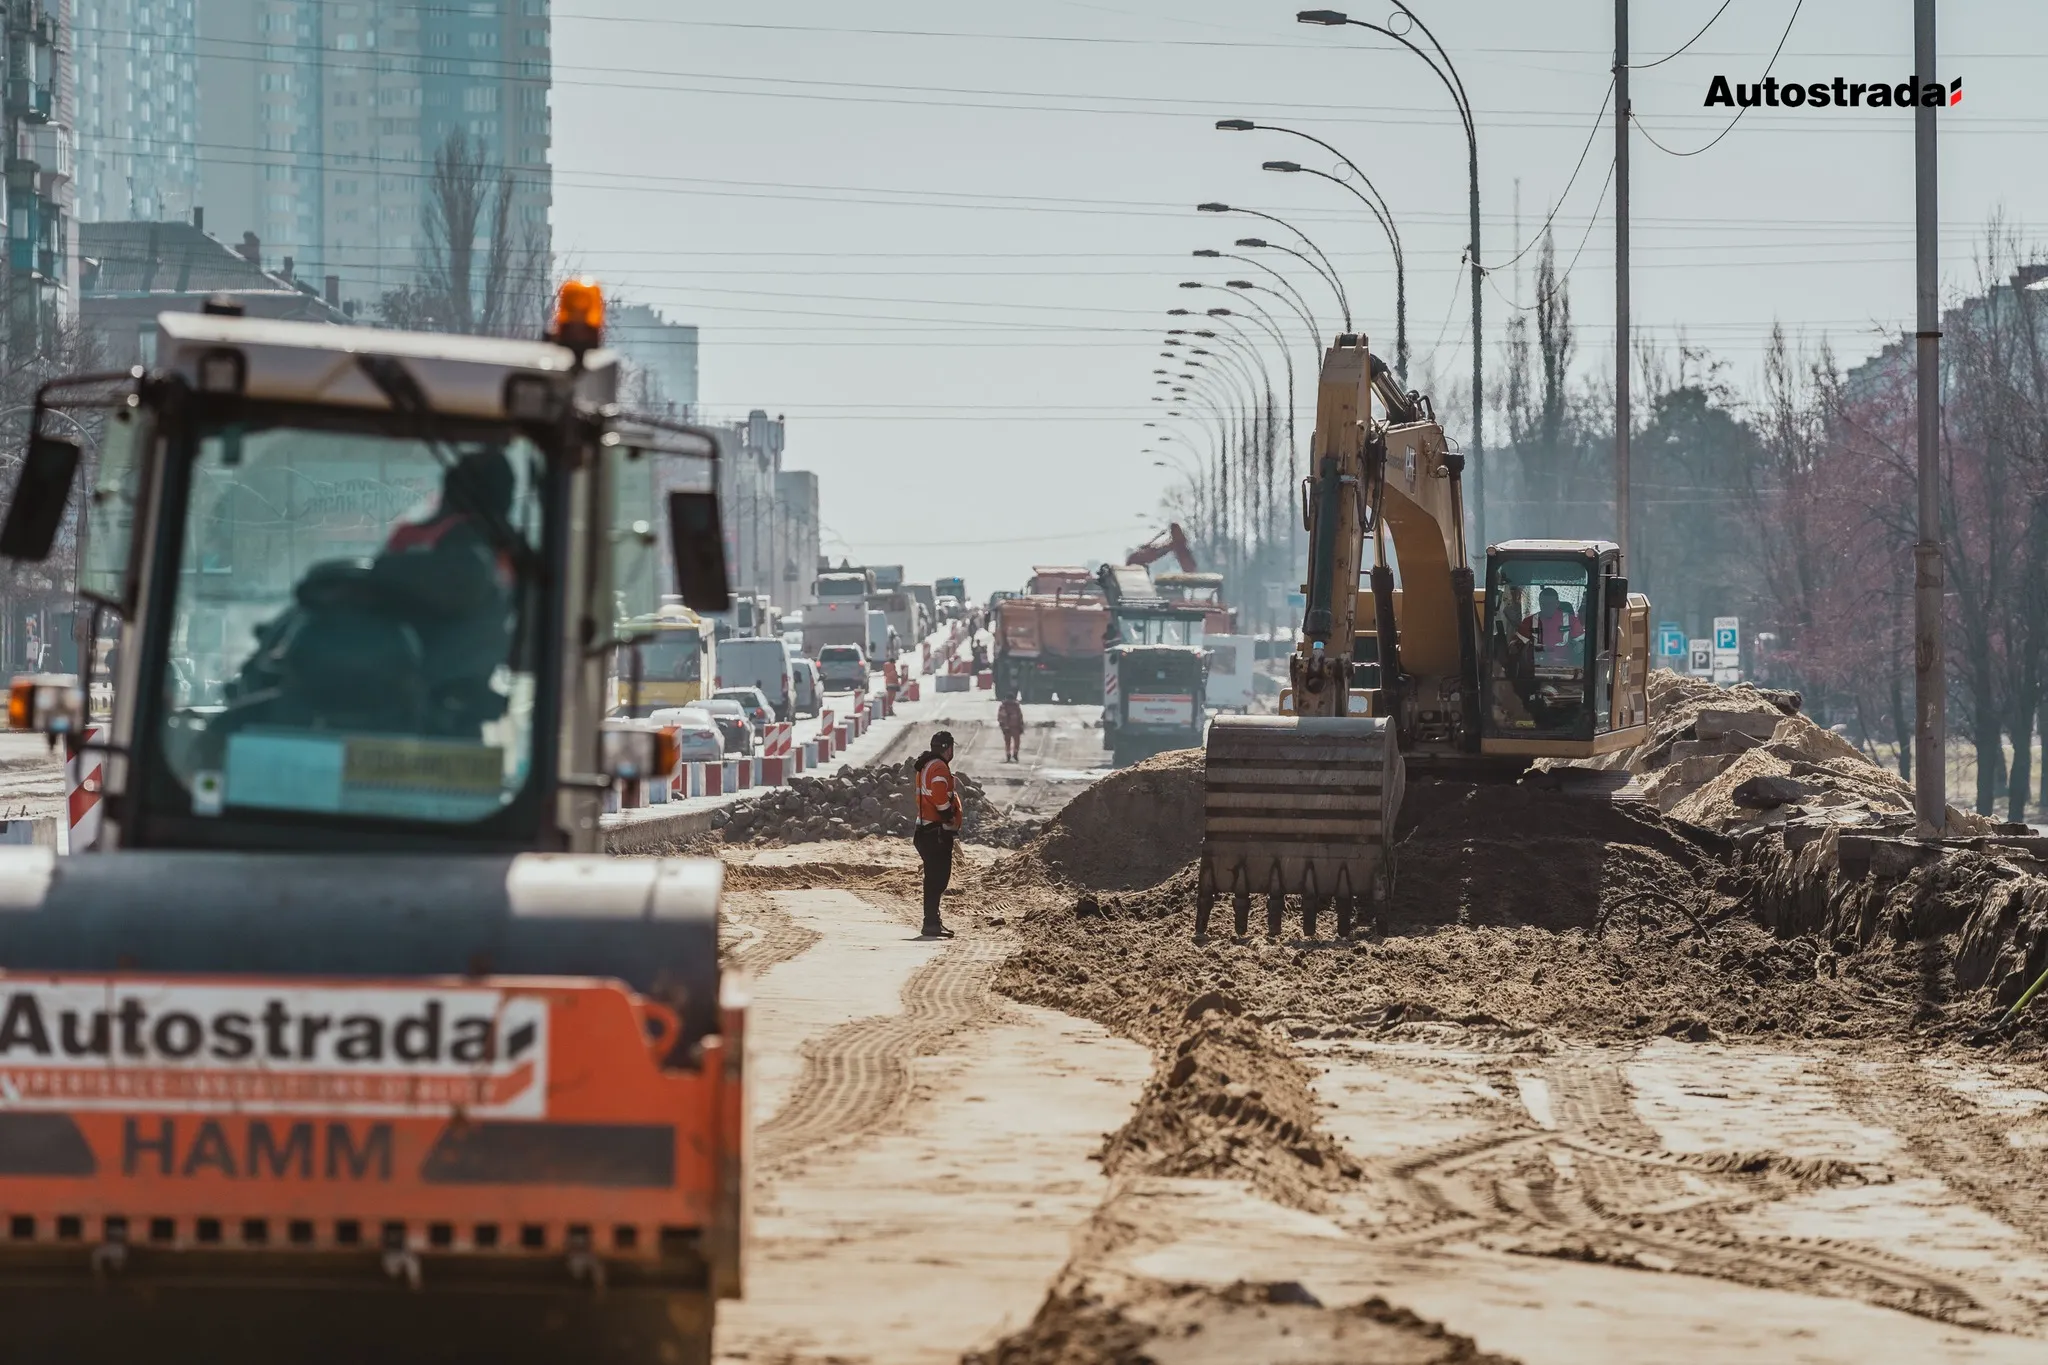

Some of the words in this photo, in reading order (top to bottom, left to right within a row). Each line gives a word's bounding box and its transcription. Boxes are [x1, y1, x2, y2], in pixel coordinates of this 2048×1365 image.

[1720, 630, 1732, 648] P
[0, 992, 497, 1063] Autostrada
[122, 1115, 394, 1181] HAMM
